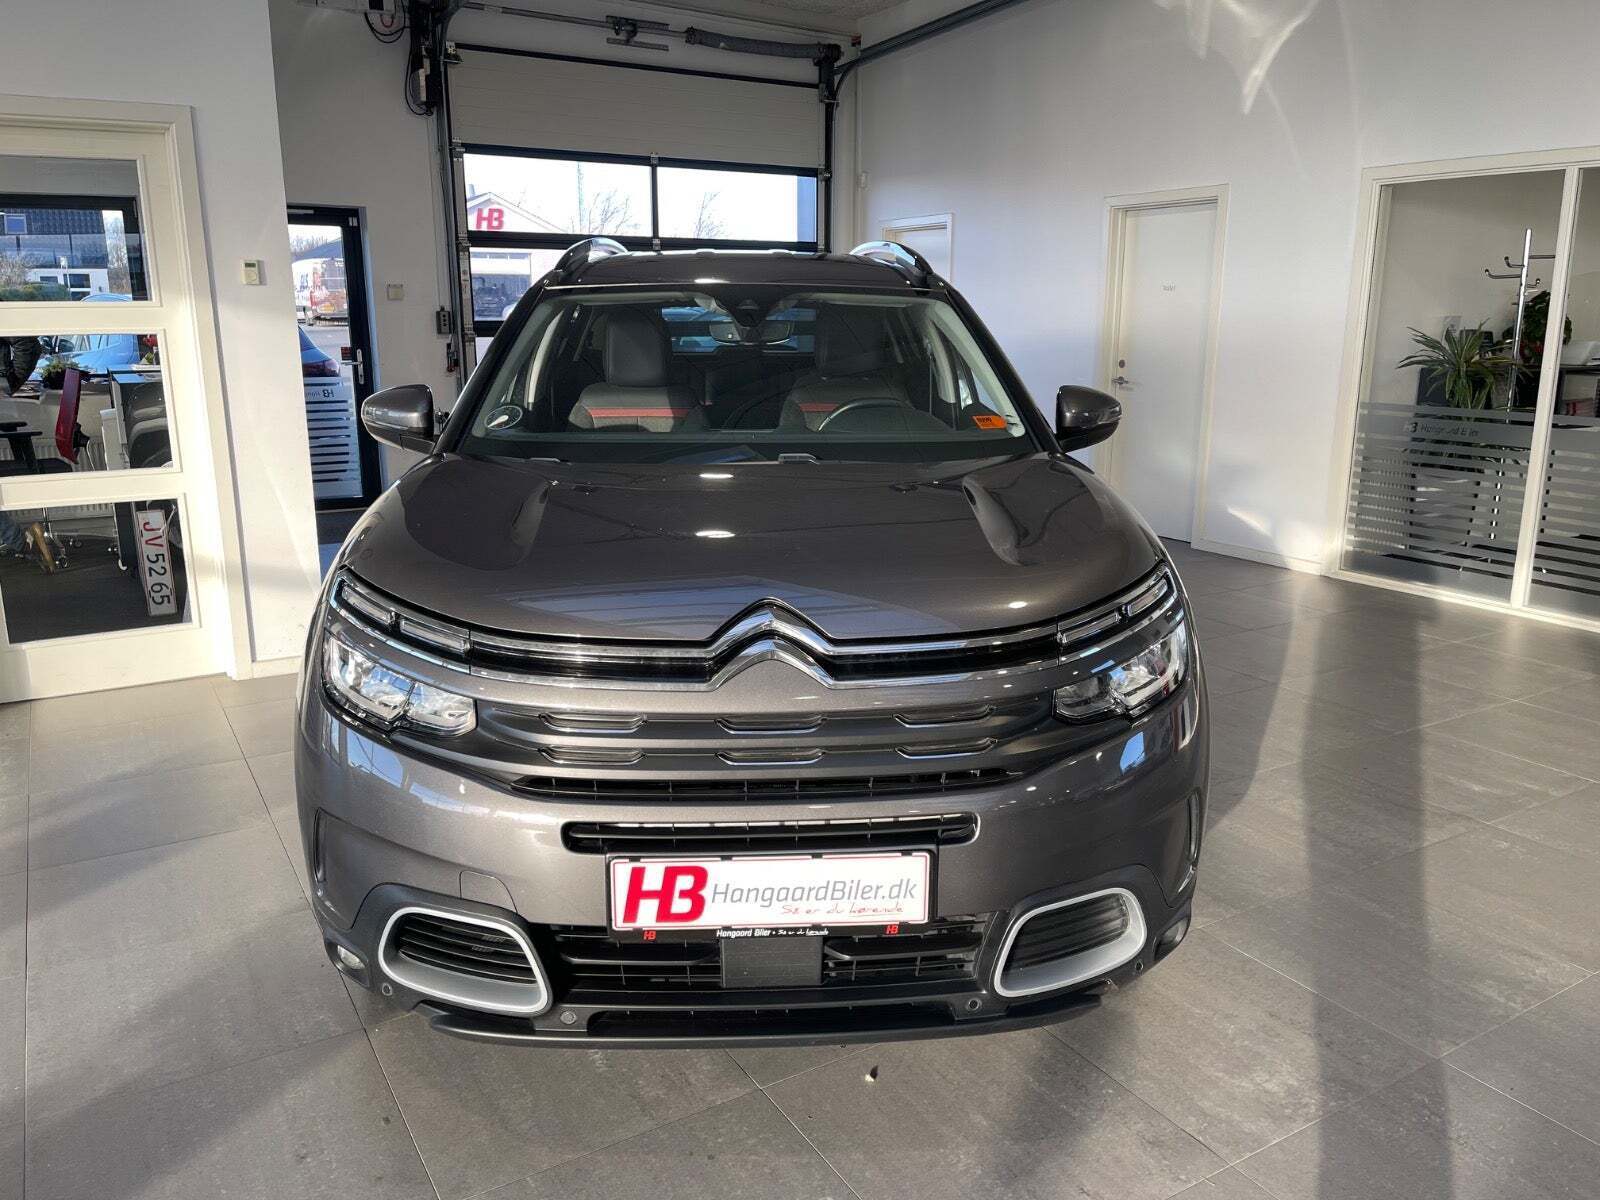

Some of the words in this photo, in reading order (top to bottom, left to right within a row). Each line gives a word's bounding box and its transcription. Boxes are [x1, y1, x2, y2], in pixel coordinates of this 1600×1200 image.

[475, 208, 504, 230] HB
[143, 521, 164, 548] JV
[146, 552, 167, 577] 52
[150, 582, 171, 606] 65
[622, 865, 708, 924] HB
[711, 878, 917, 907] HangaardBiler.dk
[643, 930, 657, 940] HB
[885, 925, 899, 935] HB
